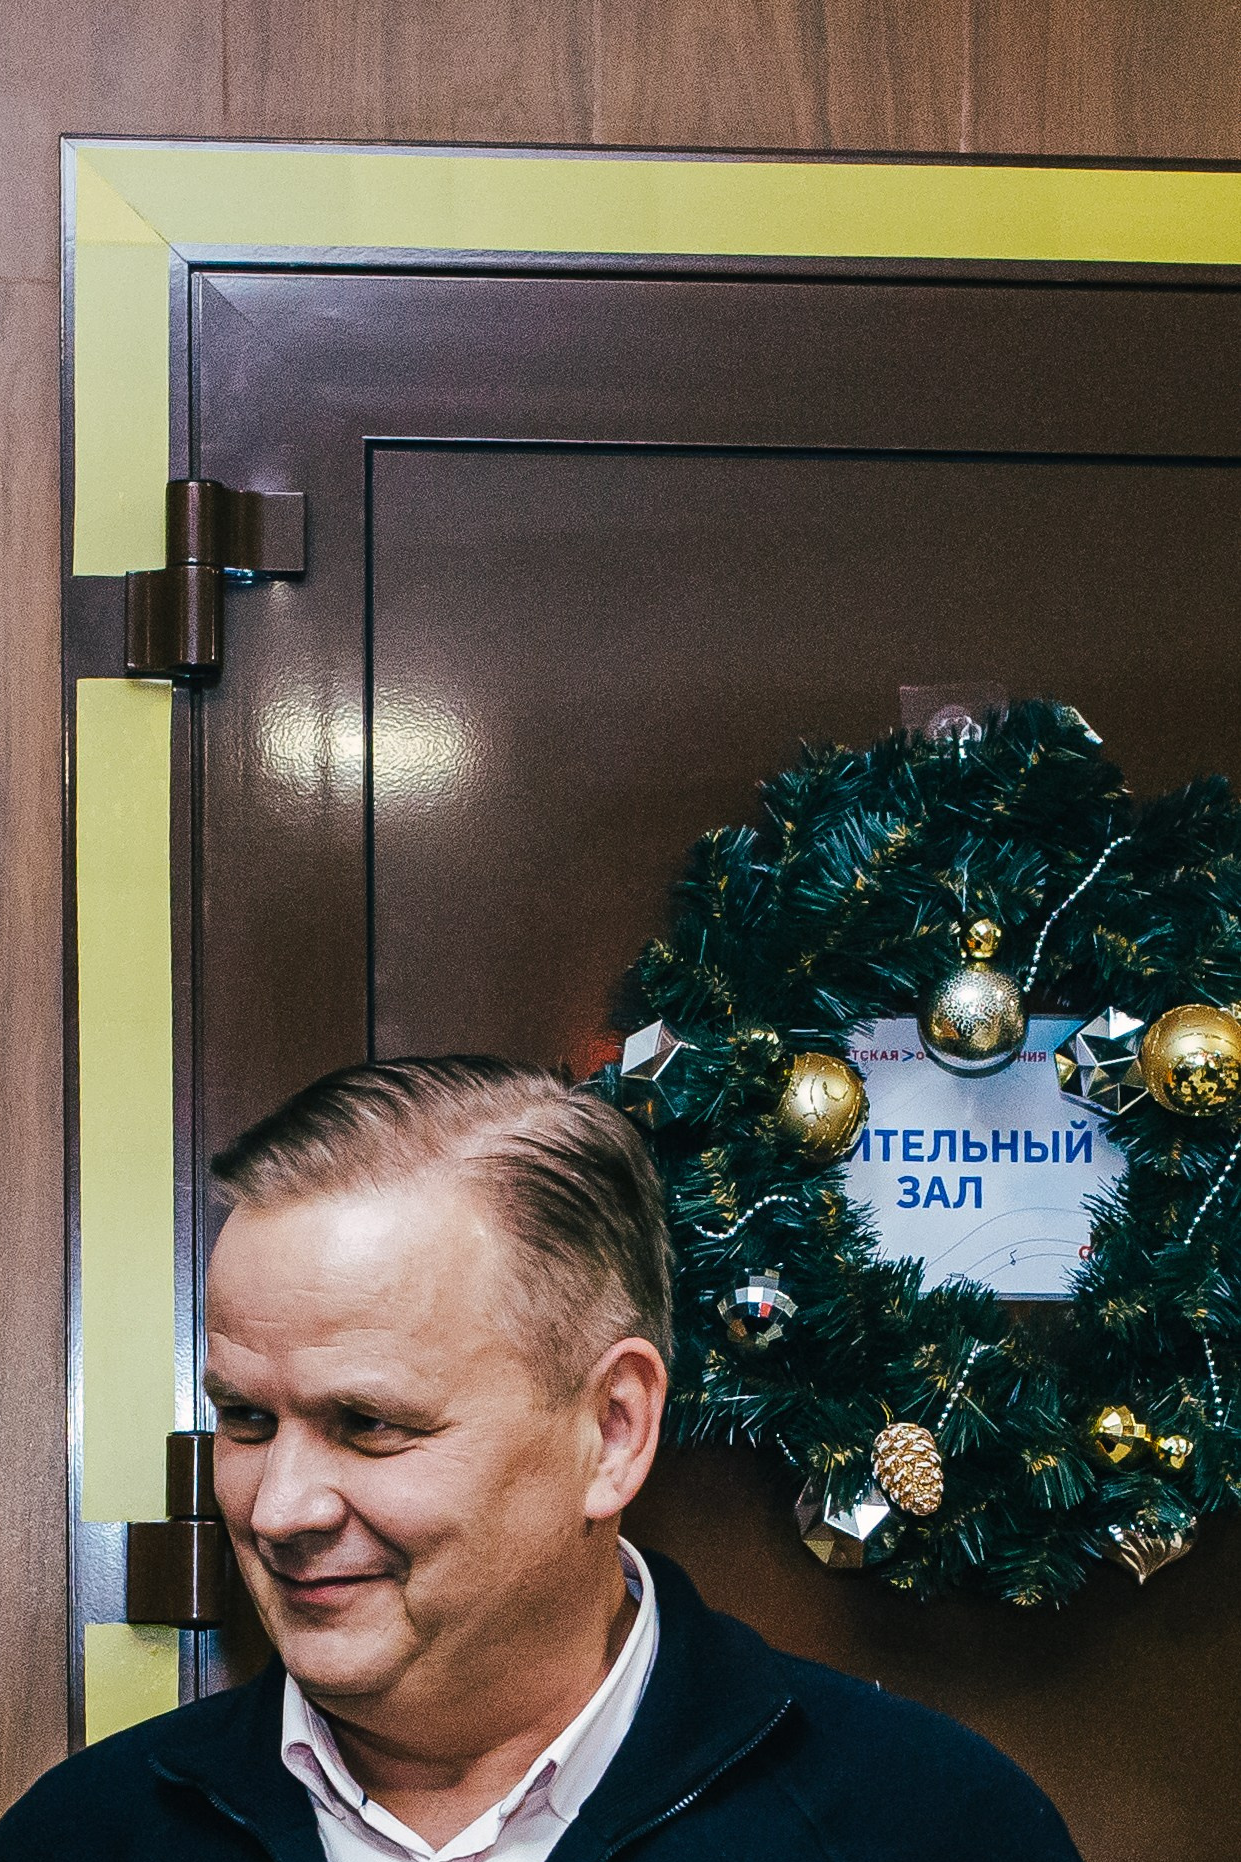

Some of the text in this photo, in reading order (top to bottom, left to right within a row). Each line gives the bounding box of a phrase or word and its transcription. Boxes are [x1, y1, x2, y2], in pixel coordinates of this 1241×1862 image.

[850, 1048, 900, 1062] ТСКАЯ
[850, 1119, 1094, 1164] ИТЕЛЬНЫЙ
[896, 1175, 983, 1210] ЗАЛ
